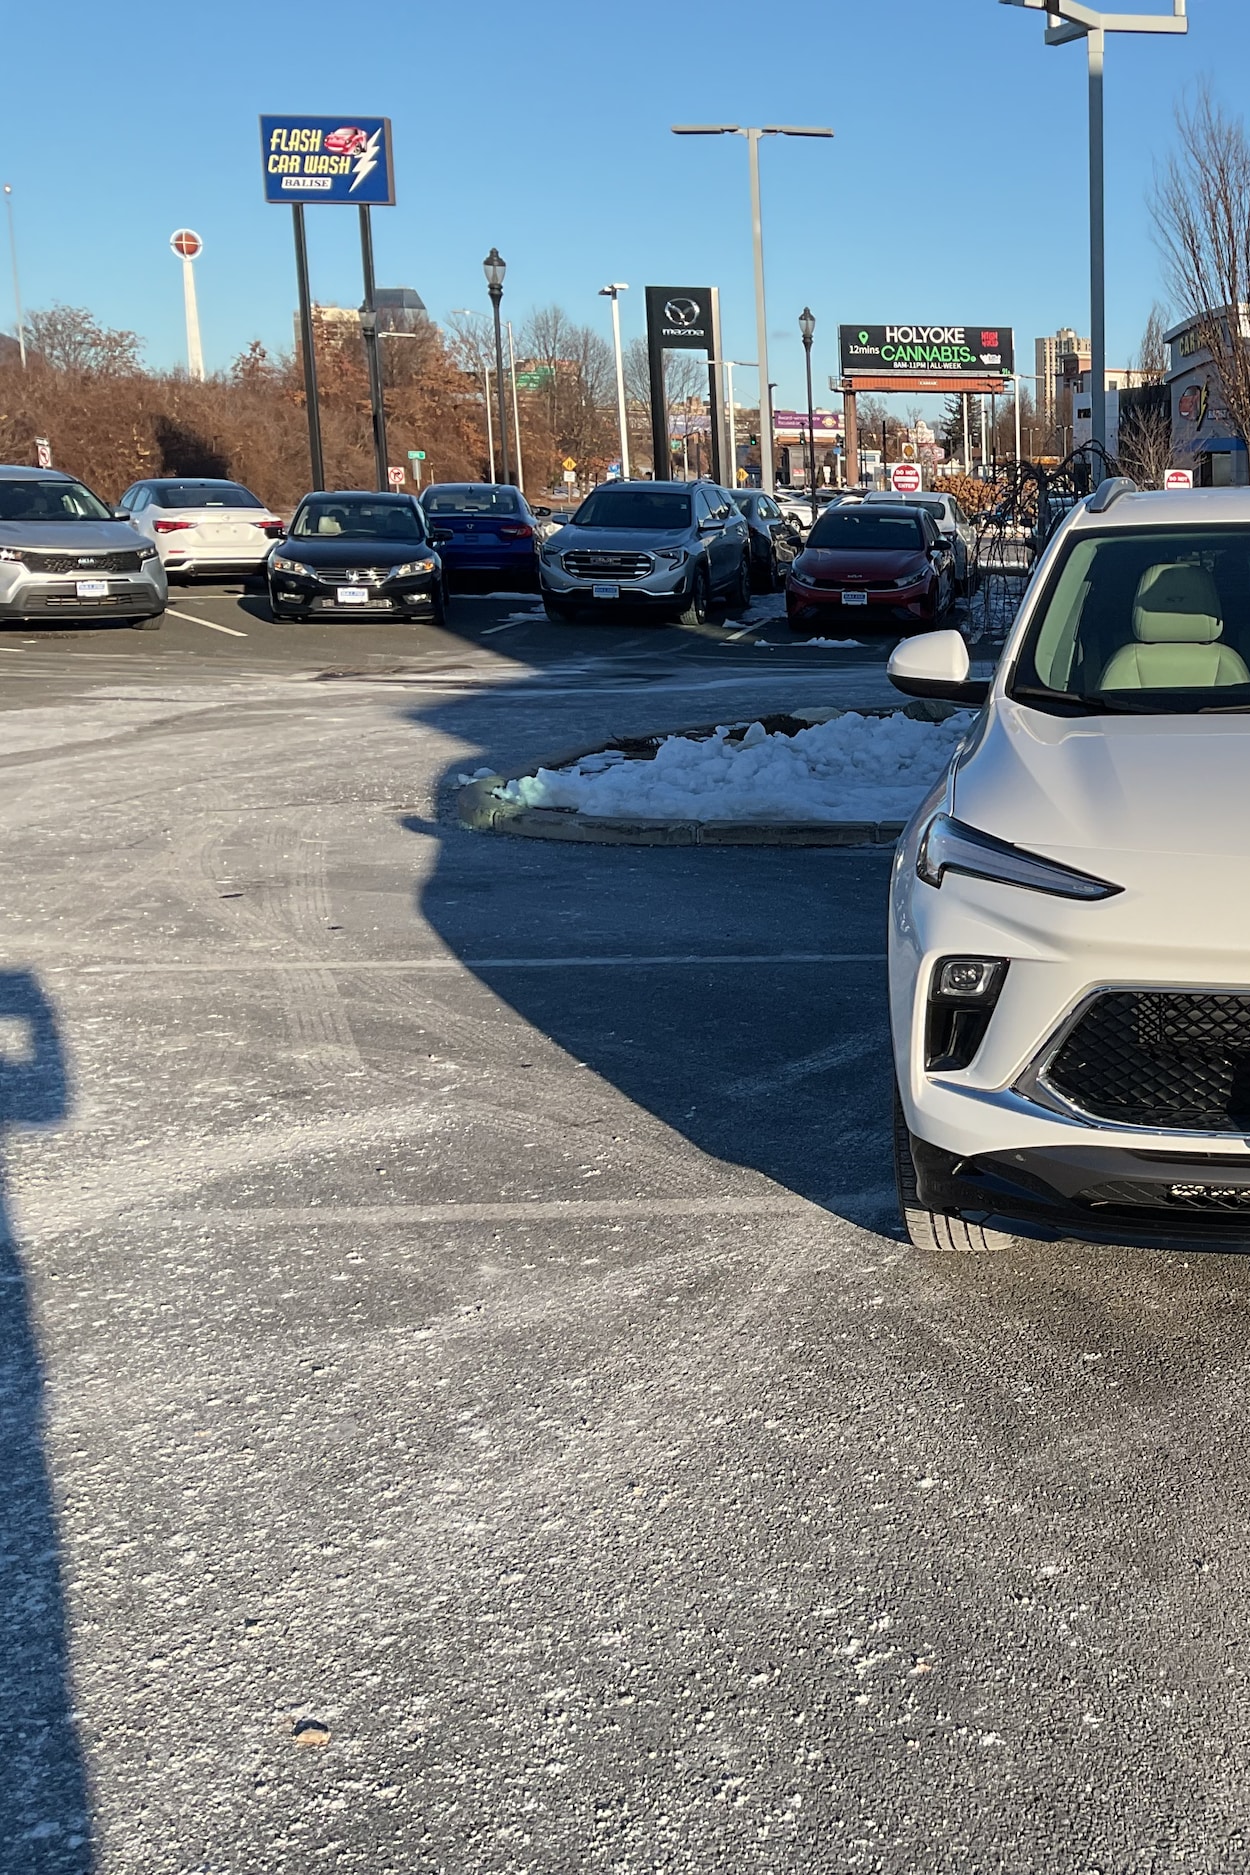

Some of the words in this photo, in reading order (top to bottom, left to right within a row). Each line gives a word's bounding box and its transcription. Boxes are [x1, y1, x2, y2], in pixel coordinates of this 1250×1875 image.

[270, 129, 322, 152] FLASH
[268, 154, 299, 173] CAR
[304, 155, 351, 175] WASH
[284, 179, 330, 187] BALISE
[885, 326, 965, 344] HOLYOKE
[849, 345, 880, 354] 12mins
[930, 362, 962, 370] ALL-WEEK
